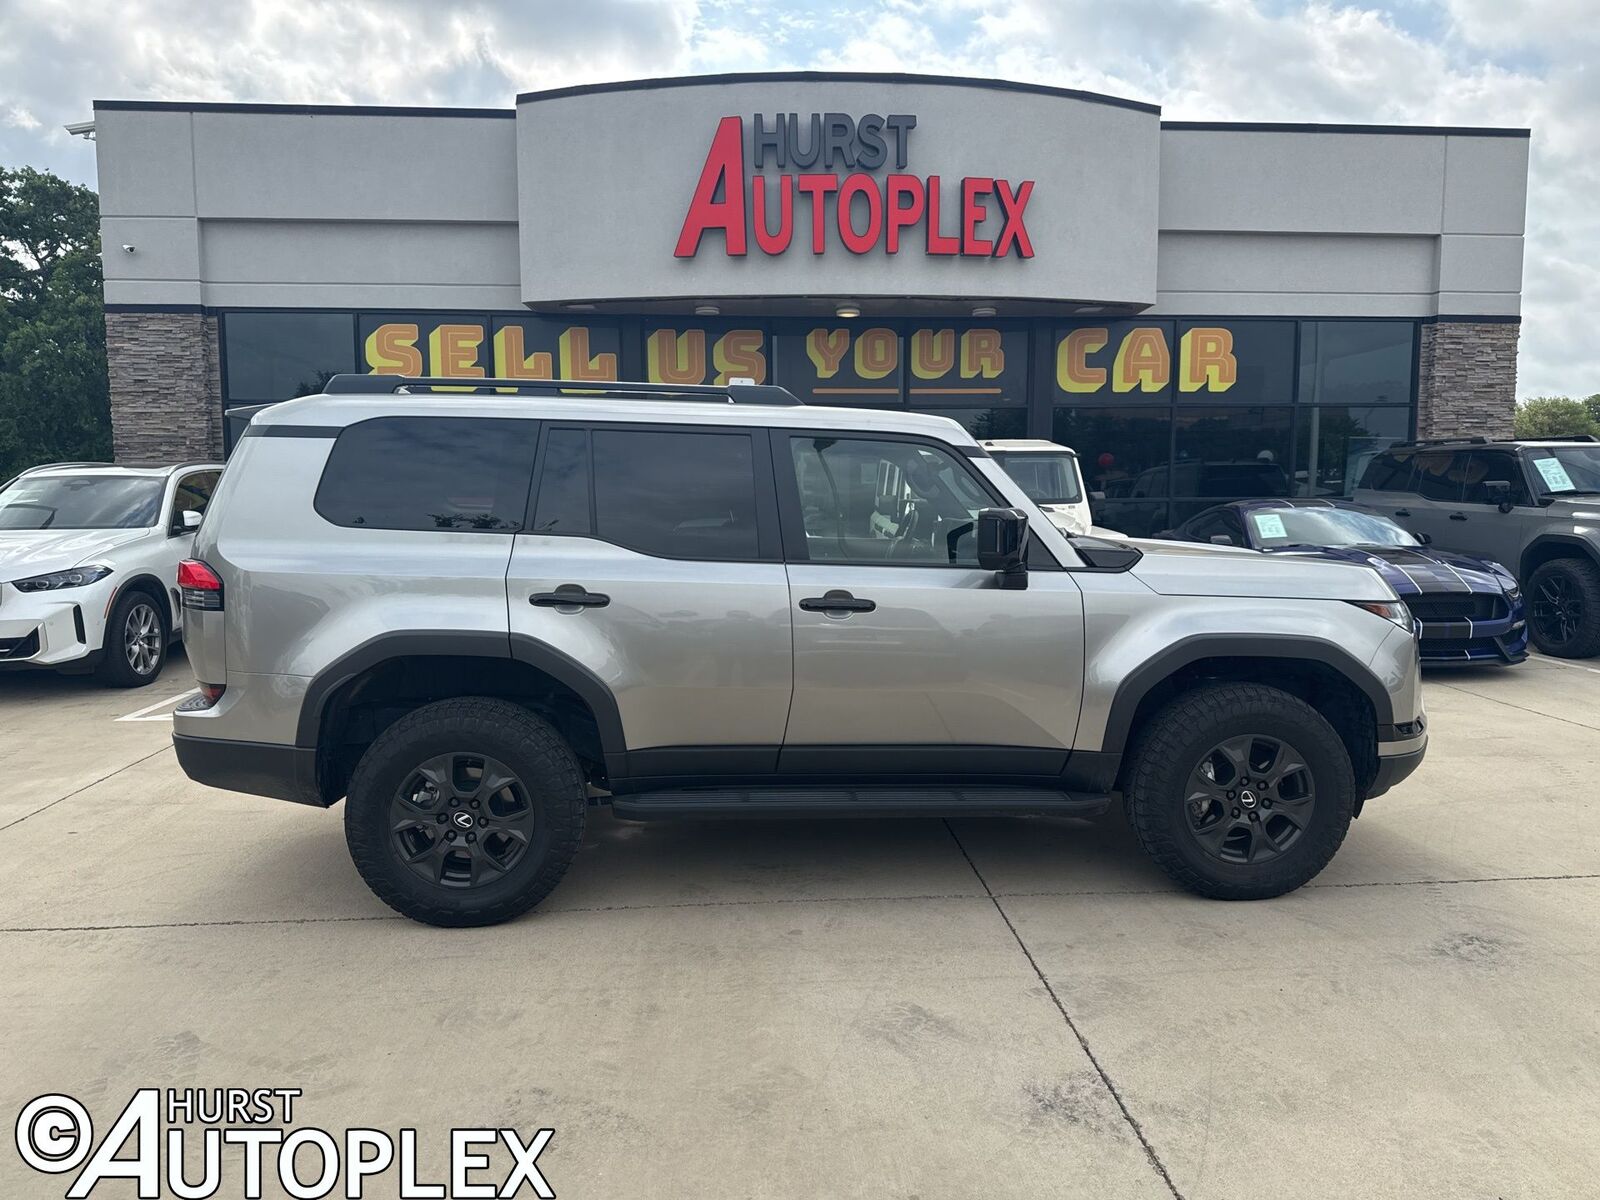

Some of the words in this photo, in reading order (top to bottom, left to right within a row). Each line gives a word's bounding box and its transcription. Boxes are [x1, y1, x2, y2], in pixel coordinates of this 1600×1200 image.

[753, 113, 917, 169] HURST
[673, 115, 1036, 258] AUTOPLEX
[365, 323, 618, 393] SELL
[648, 328, 767, 386] US
[806, 328, 1004, 379] YOUR
[1056, 327, 1237, 393] CAR
